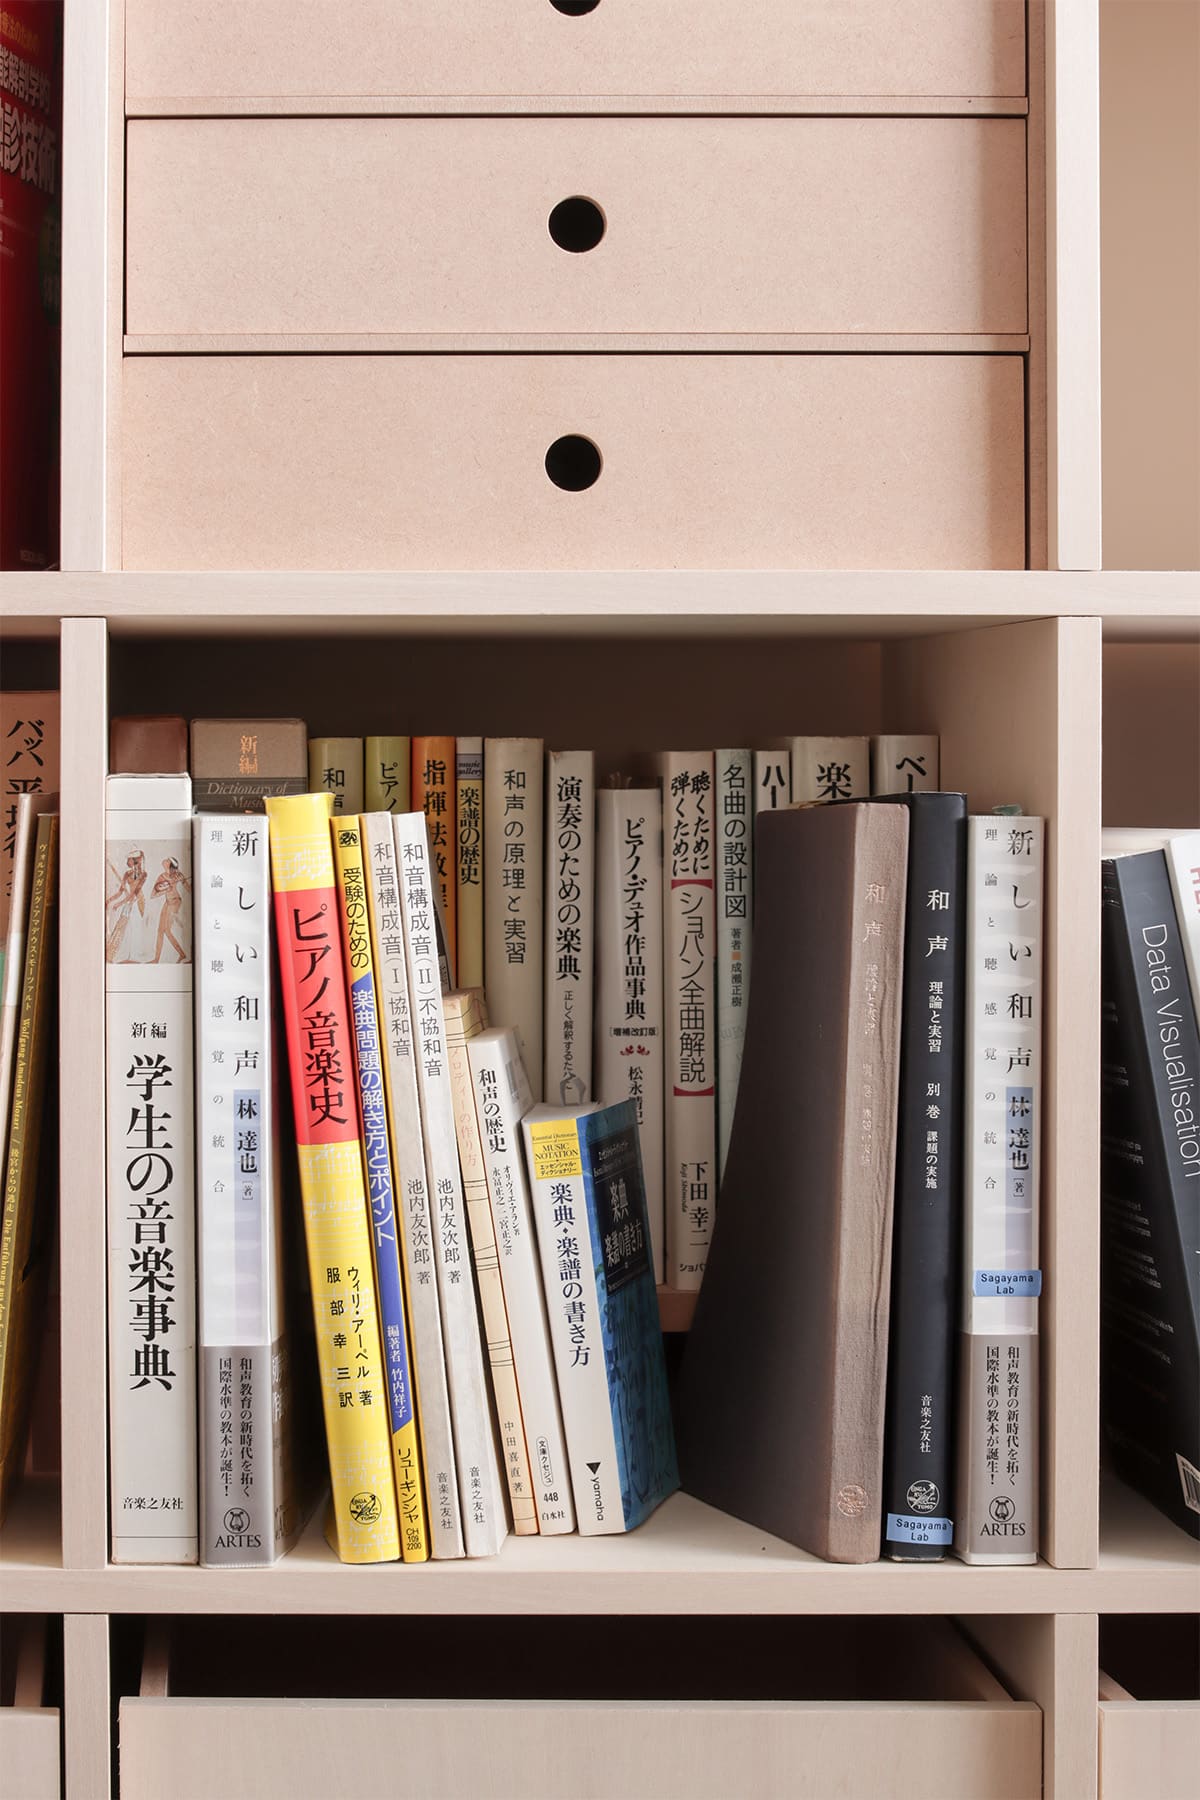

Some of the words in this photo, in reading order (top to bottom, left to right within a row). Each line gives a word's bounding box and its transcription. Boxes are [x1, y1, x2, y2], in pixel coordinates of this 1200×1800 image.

[6, 719, 45, 767] バッハ
[207, 781, 274, 795] Dictionary
[275, 782, 288, 796] of
[379, 761, 400, 811] ピアノ
[816, 762, 852, 799] 楽
[459, 786, 481, 886] 楽譜の歴史
[671, 772, 690, 877] 弾くために
[690, 771, 711, 875] 聴くために
[722, 764, 747, 919] 名曲の設計図
[502, 769, 527, 964] 和声の原理と実習
[556, 775, 582, 981] 演奏のための楽典
[343, 867, 370, 969] 受験のための
[623, 817, 648, 1021] ピアノ・デュオ作品事典
[731, 928, 742, 950] 著者
[863, 883, 886, 942] 和声
[926, 889, 950, 958] 和声
[232, 830, 260, 1076] 新しい和声
[1006, 829, 1033, 1073] 新しい和声
[1142, 923, 1172, 994] Data
[210, 830, 225, 1193] 理論と聴感覚の統合
[293, 903, 348, 1127] ピアノ音楽史
[679, 891, 706, 1083] ショパン全曲解説
[984, 828, 998, 1190] 理論と聴感覚の統合
[18, 1018, 31, 1058] Wolfgang
[131, 1022, 167, 1039] 新編
[927, 981, 944, 1053] 理論と実習
[14, 1060, 27, 1098] Amadeus
[1156, 998, 1200, 1177] Visualisation
[13, 1099, 24, 1130] Mozart
[351, 991, 395, 1247] 楽典問題の解き方とポイント
[478, 1068, 507, 1154] 和声の歴史
[535, 1149, 579, 1160] NOTATION
[542, 1143, 570, 1152] MUSIC
[925, 1130, 938, 1189] 課題の実施
[126, 1054, 176, 1391] 学生の音楽事典
[688, 1161, 709, 1245] 下田幸二
[981, 1273, 1034, 1285] Sagayama
[996, 1285, 1015, 1295] Lab
[219, 1357, 233, 1497] 国際水準の教本が誕生!
[239, 1358, 253, 1498] 和声教育の新時代を拓く
[919, 1395, 933, 1453] 音楽之友社
[986, 1345, 1000, 1485] 国際水準の教本が誕生!
[1006, 1345, 1020, 1486] 和声教育の新時代を拓く
[398, 1448, 419, 1522] リューギンシャ
[538, 1440, 553, 1484] 文庫クセジュ
[122, 1496, 184, 1511] 音楽之友社
[436, 1471, 453, 1530] 音楽之友社
[469, 1465, 486, 1524] 音楽之友社
[541, 1511, 565, 1522] 白水社
[543, 1492, 559, 1502] 448
[593, 1476, 605, 1521] yamaha
[214, 1535, 262, 1549] ARTES
[405, 1528, 419, 1537] CH
[406, 1542, 422, 1550] 2200
[896, 1518, 948, 1533] Sagayama
[910, 1531, 929, 1542] Lab
[979, 1522, 1026, 1536] ARTES
